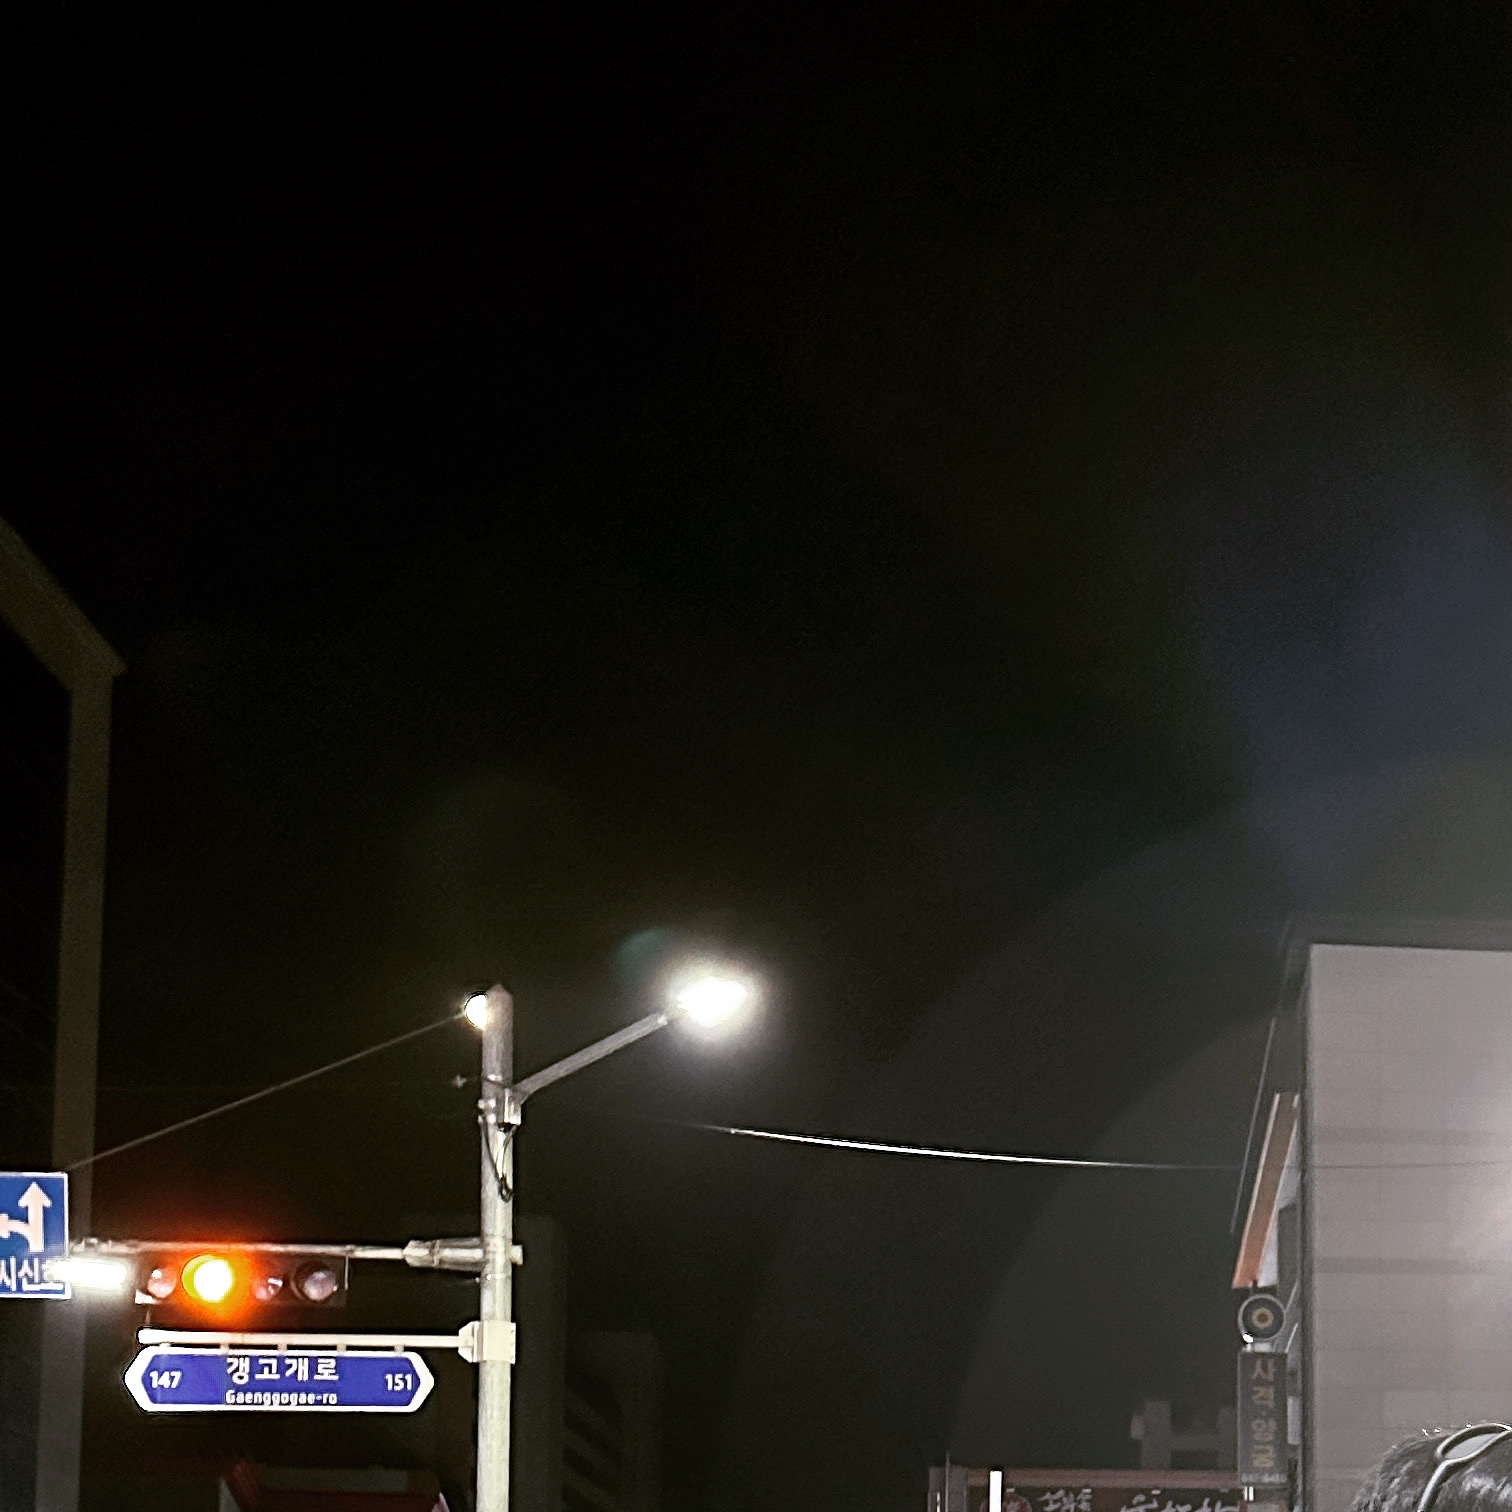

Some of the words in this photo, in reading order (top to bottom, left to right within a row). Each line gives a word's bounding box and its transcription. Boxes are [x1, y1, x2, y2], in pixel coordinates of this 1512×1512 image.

[226, 1357, 339, 1384] 갱고개로
[150, 1371, 182, 1389] 147
[385, 1373, 412, 1391] 151
[225, 1389, 337, 1406] Gaenggogae-ro
